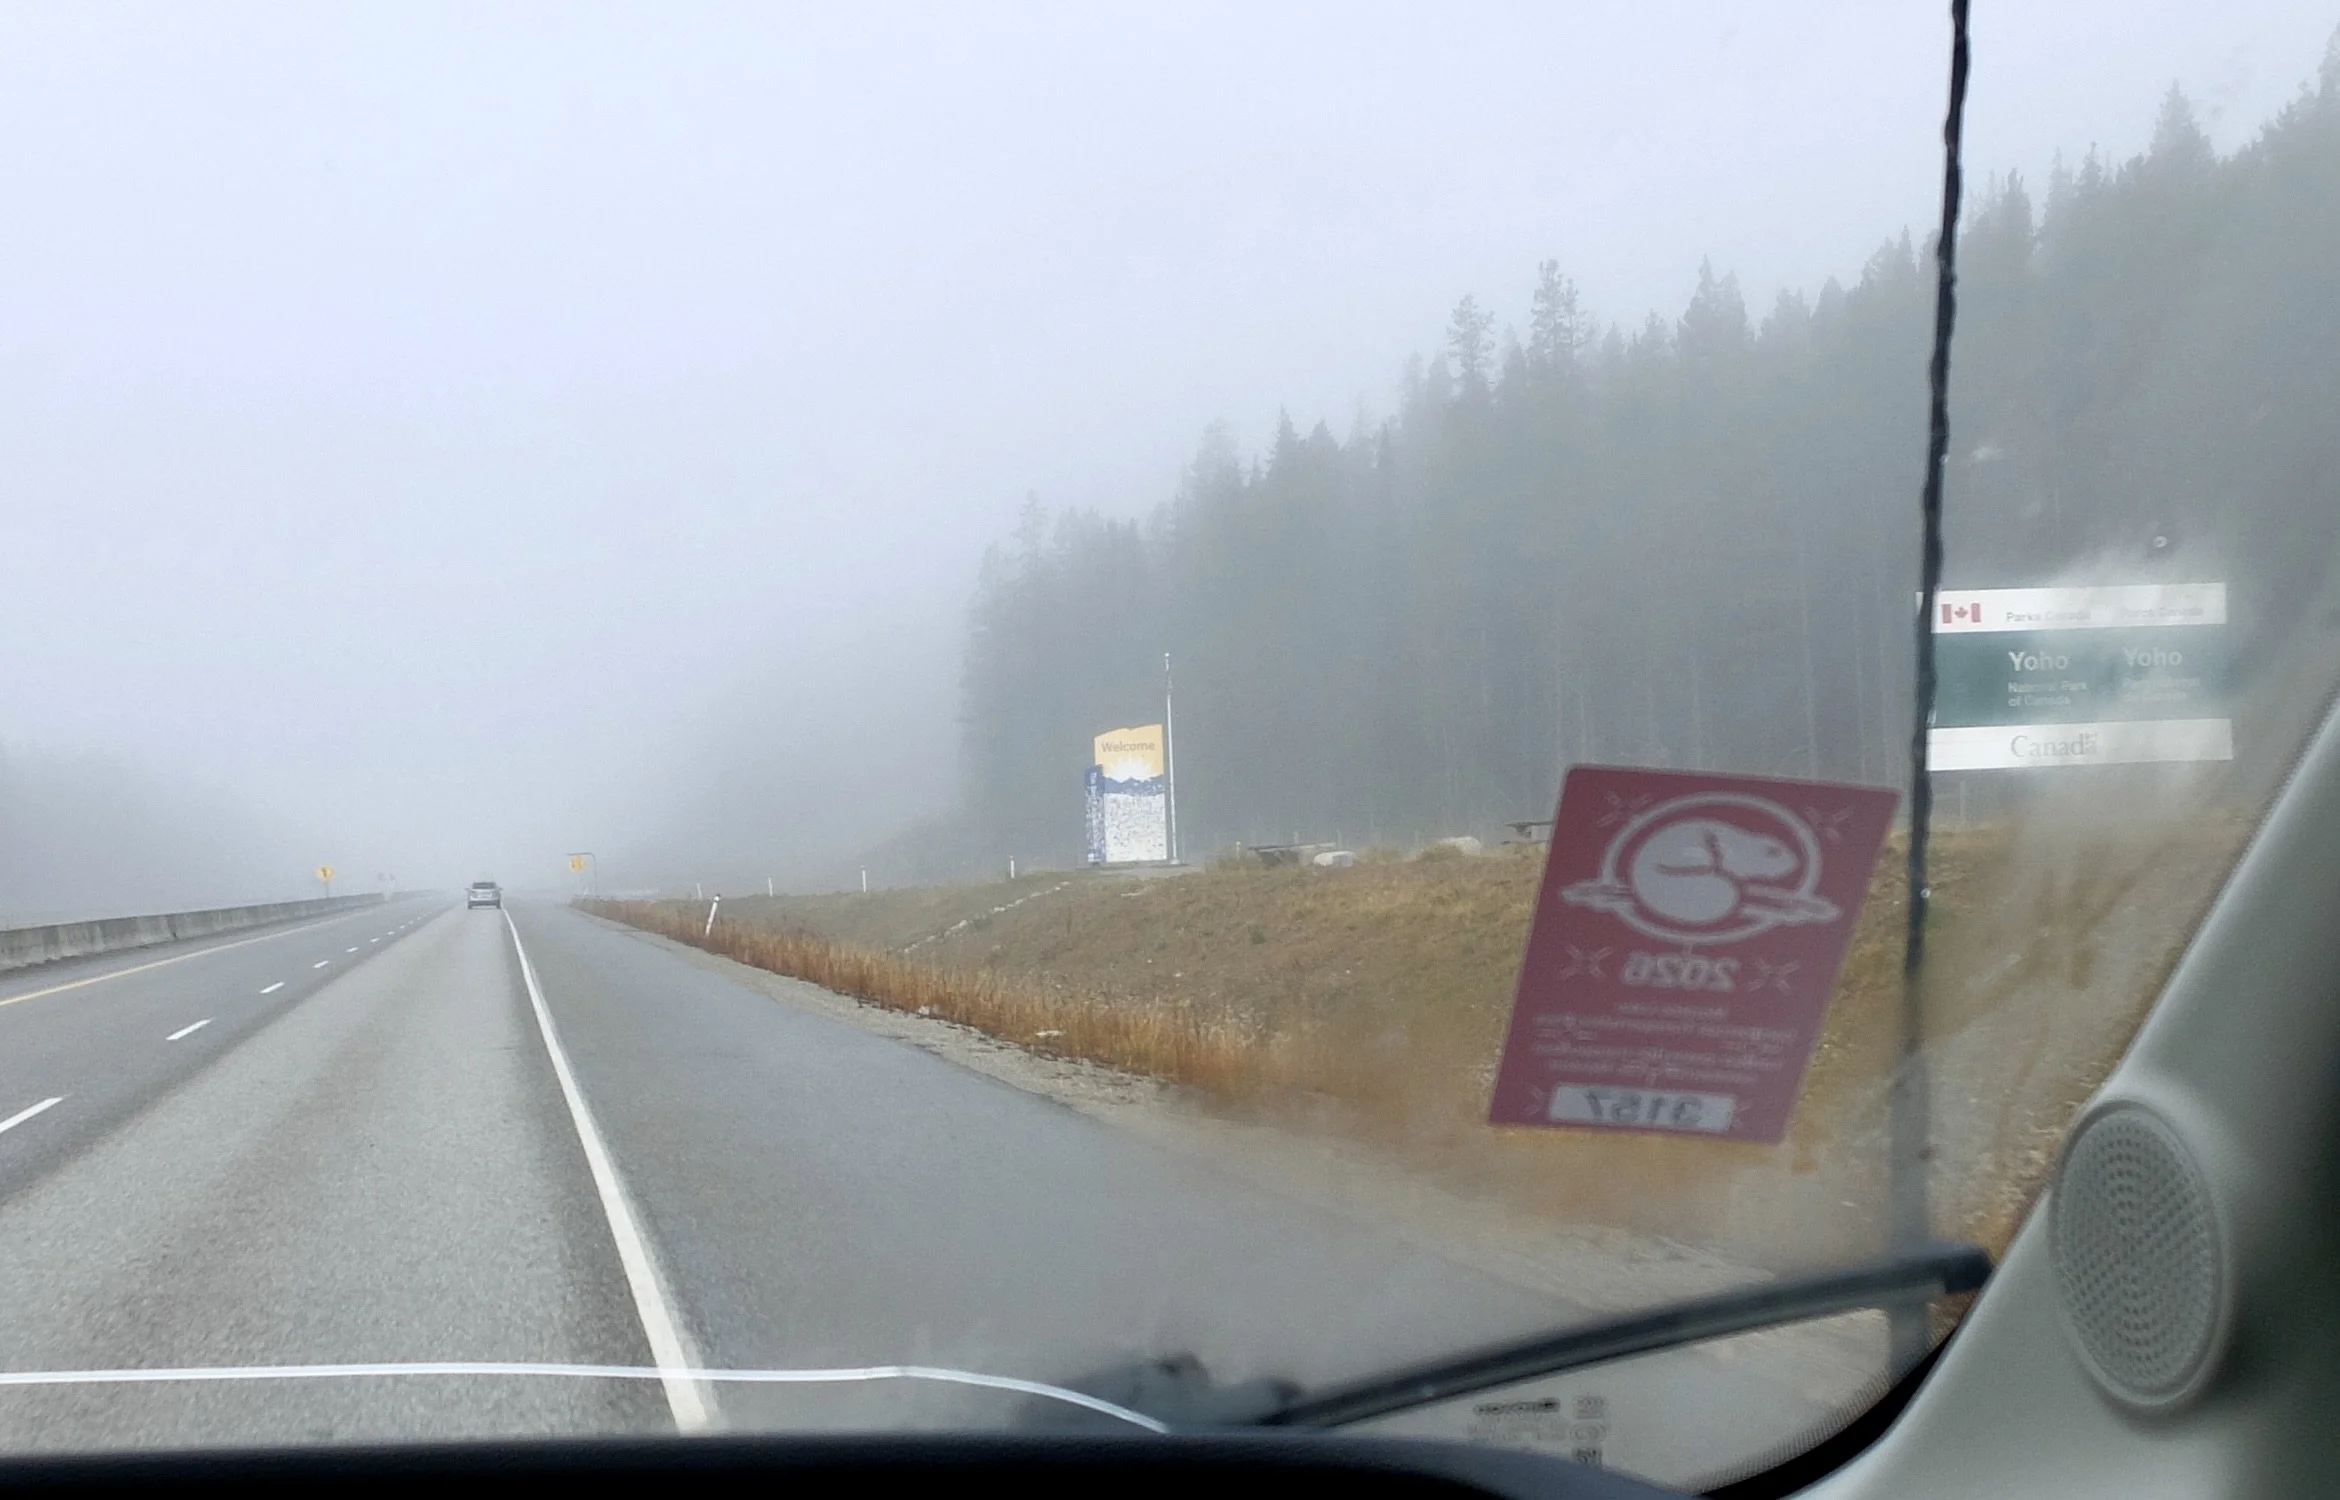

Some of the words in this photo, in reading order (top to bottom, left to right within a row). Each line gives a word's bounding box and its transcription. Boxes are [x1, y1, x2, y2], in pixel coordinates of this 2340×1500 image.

[2007, 650, 2070, 671] Yoho
[2122, 646, 2183, 667] Yoho
[1101, 740, 1156, 753] Welcome
[2010, 732, 2097, 758] Canada
